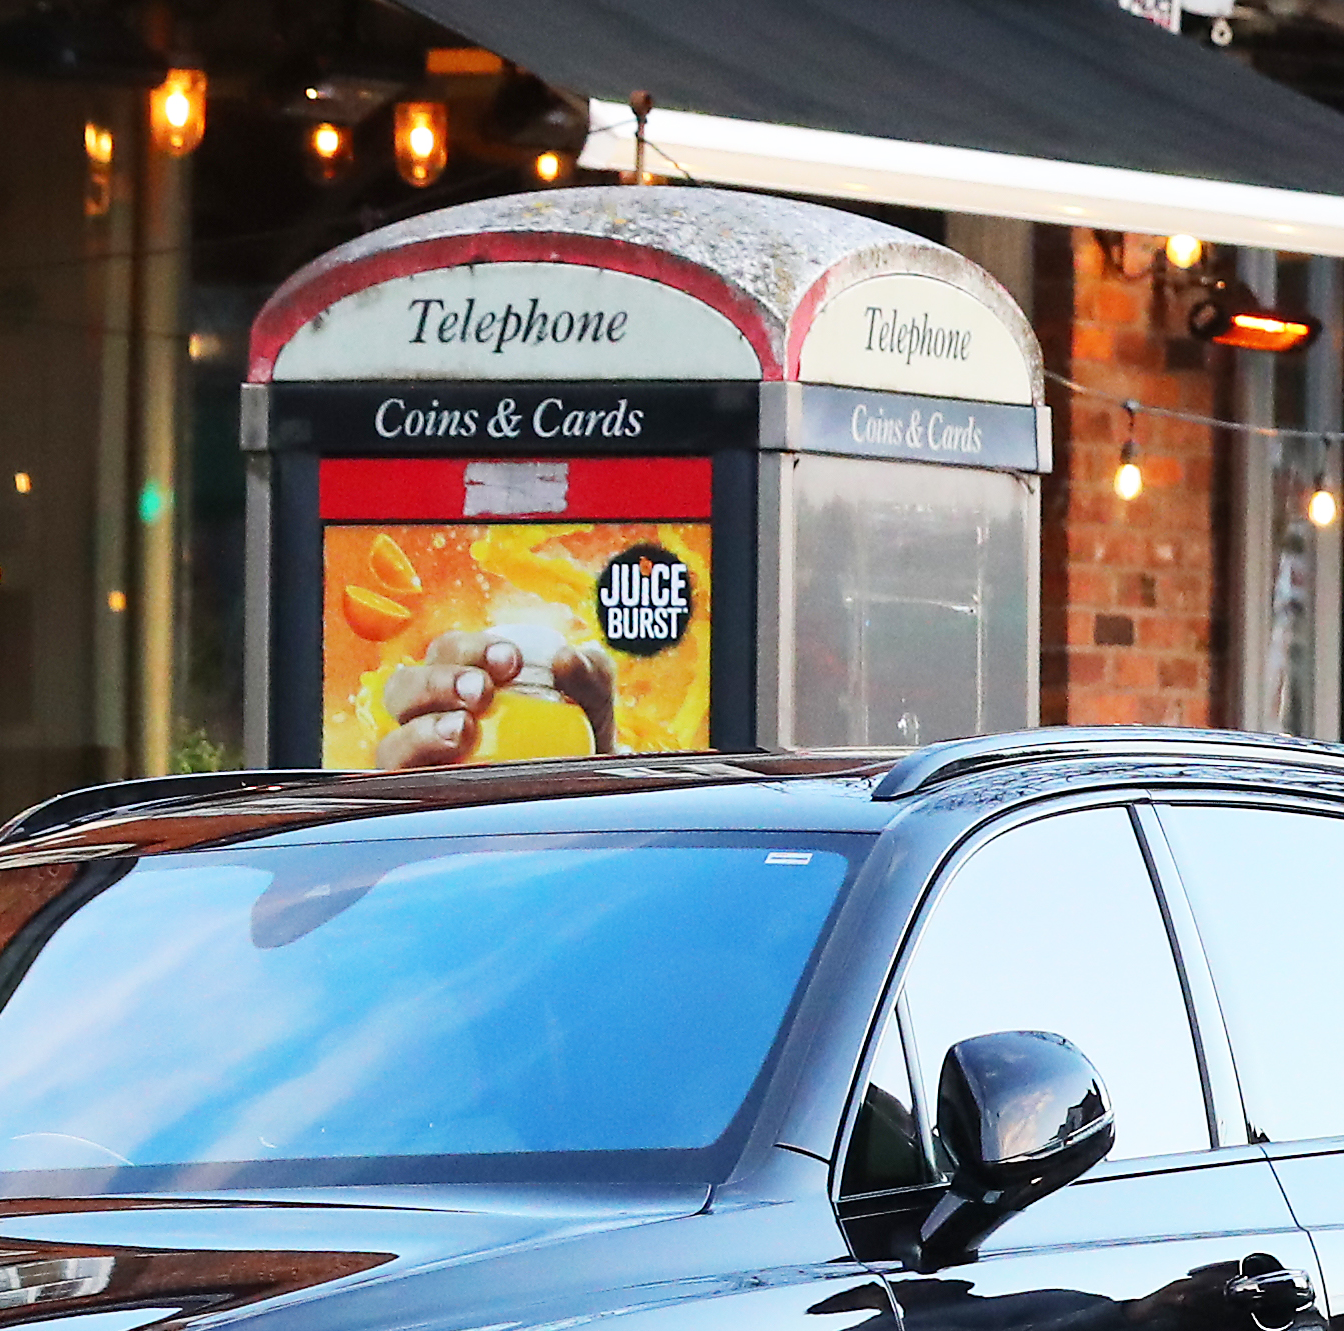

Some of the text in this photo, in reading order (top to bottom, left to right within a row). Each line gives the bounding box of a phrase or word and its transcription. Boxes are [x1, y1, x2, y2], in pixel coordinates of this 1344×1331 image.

[408, 297, 628, 353] Telephone
[864, 306, 973, 366] Telephone
[375, 398, 645, 438] Coins & Cards
[851, 404, 983, 454] Coins & Cards
[607, 607, 683, 640] BURST
